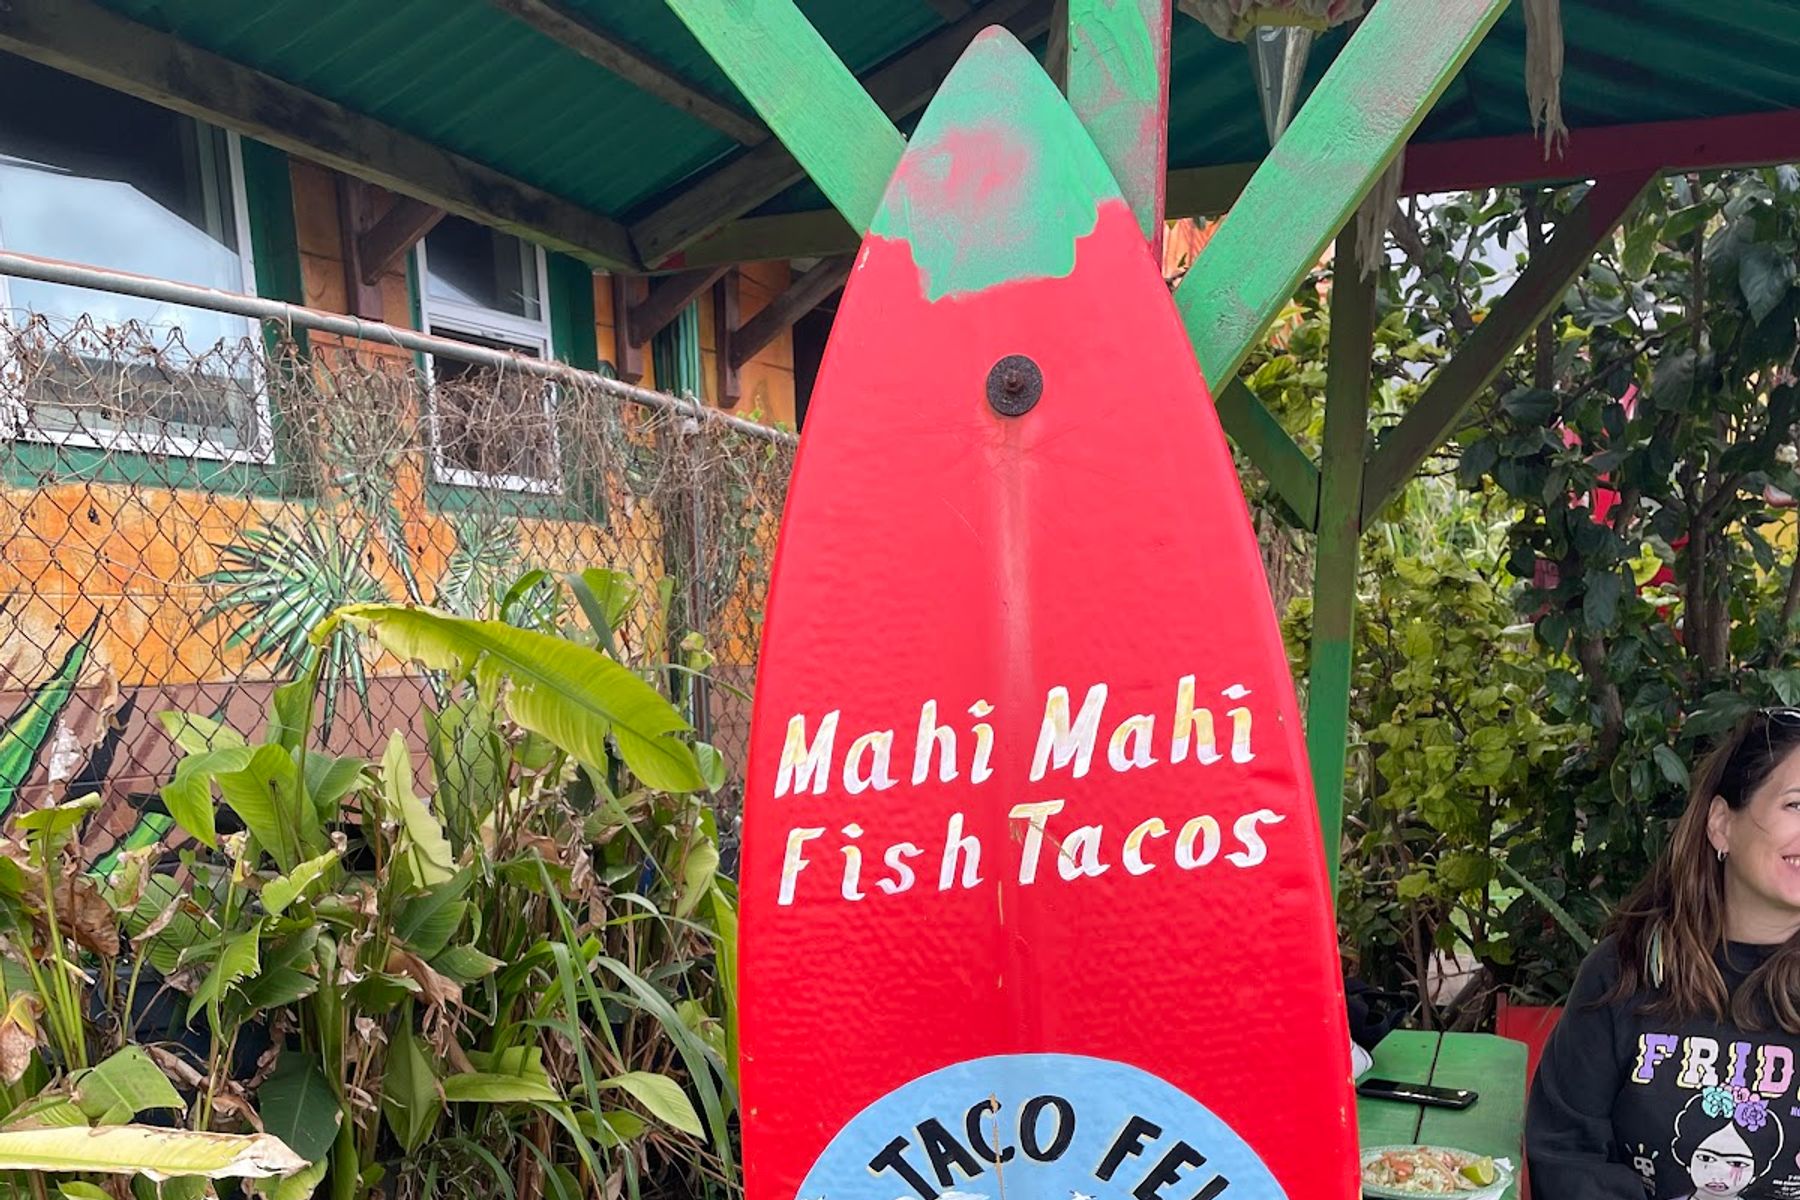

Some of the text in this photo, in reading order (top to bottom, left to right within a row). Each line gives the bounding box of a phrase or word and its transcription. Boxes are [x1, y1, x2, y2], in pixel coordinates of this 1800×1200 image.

[774, 674, 1257, 799] Mahi Mahi
[776, 799, 1287, 906] Fish Tacos
[1630, 1032, 1800, 1098] FRID
